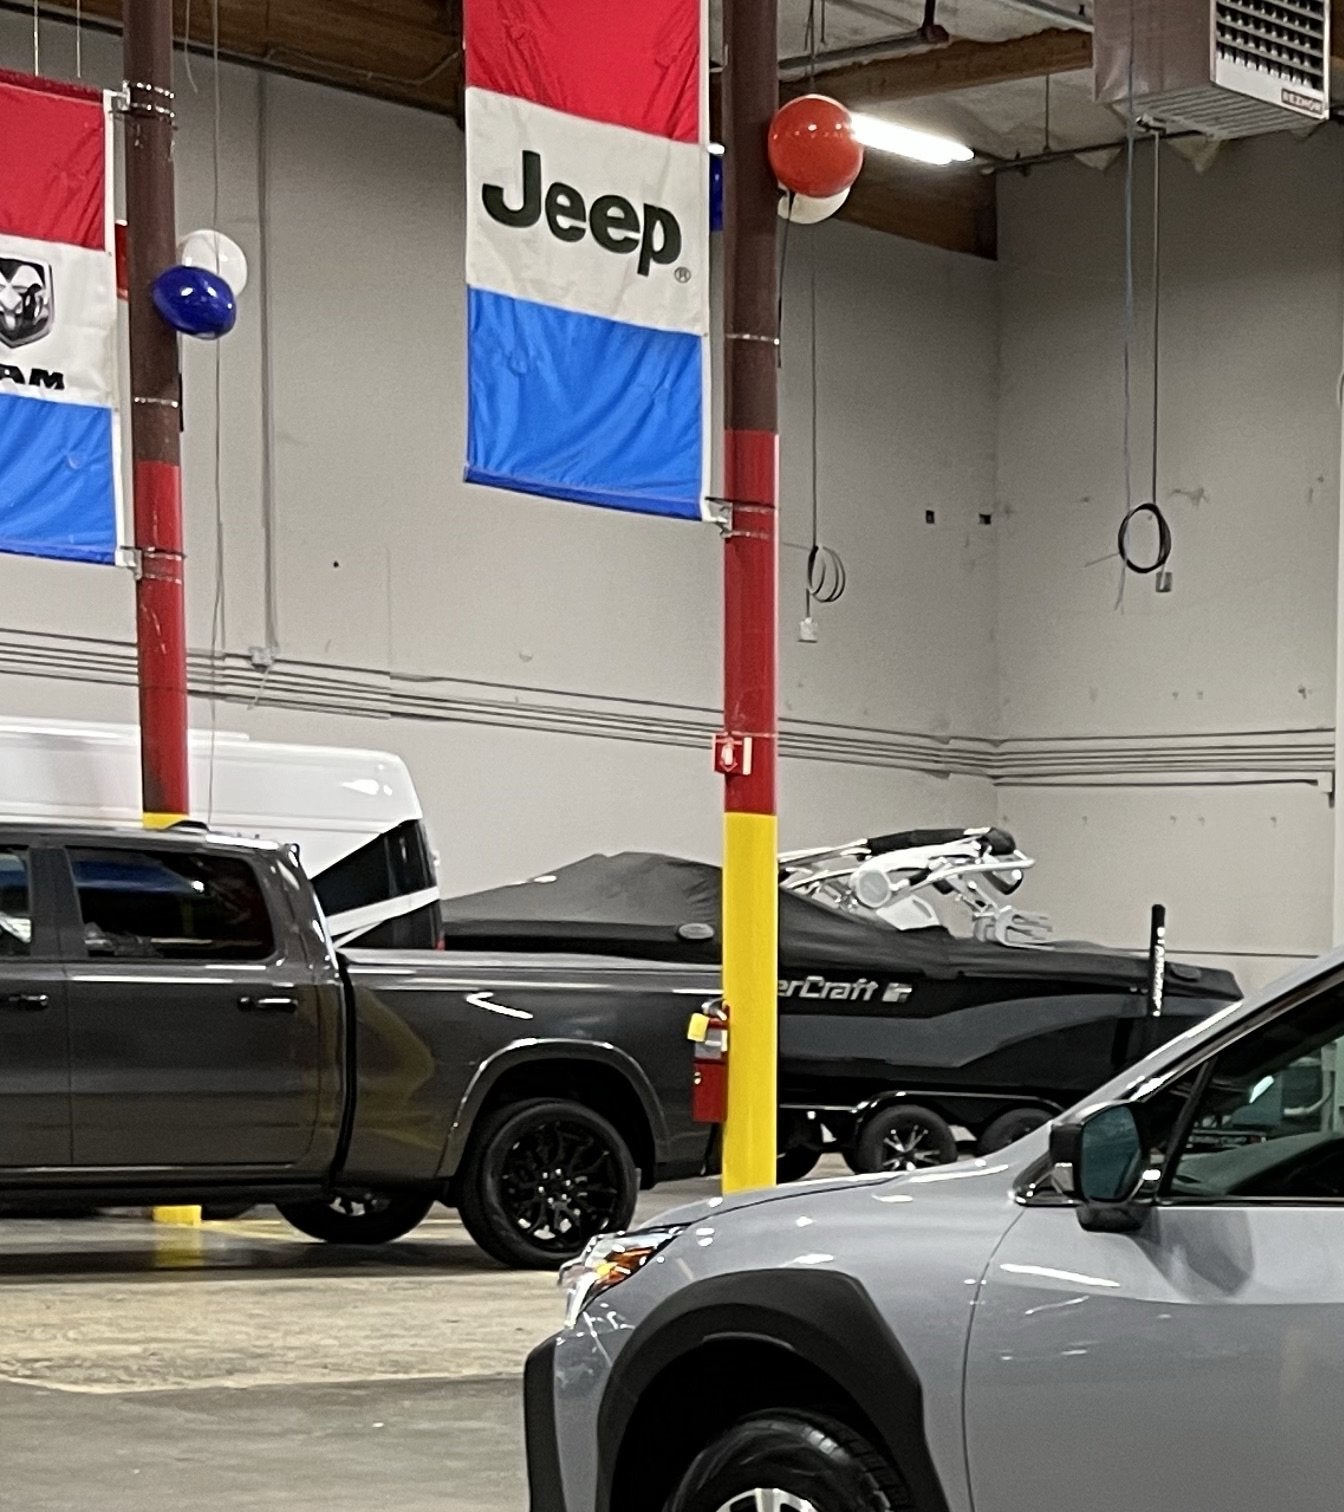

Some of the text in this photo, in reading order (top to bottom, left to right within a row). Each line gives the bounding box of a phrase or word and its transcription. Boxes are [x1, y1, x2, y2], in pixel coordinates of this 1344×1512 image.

[482, 150, 682, 276] Jeep
[0, 364, 65, 390] AM
[778, 976, 878, 1001] erCraft
